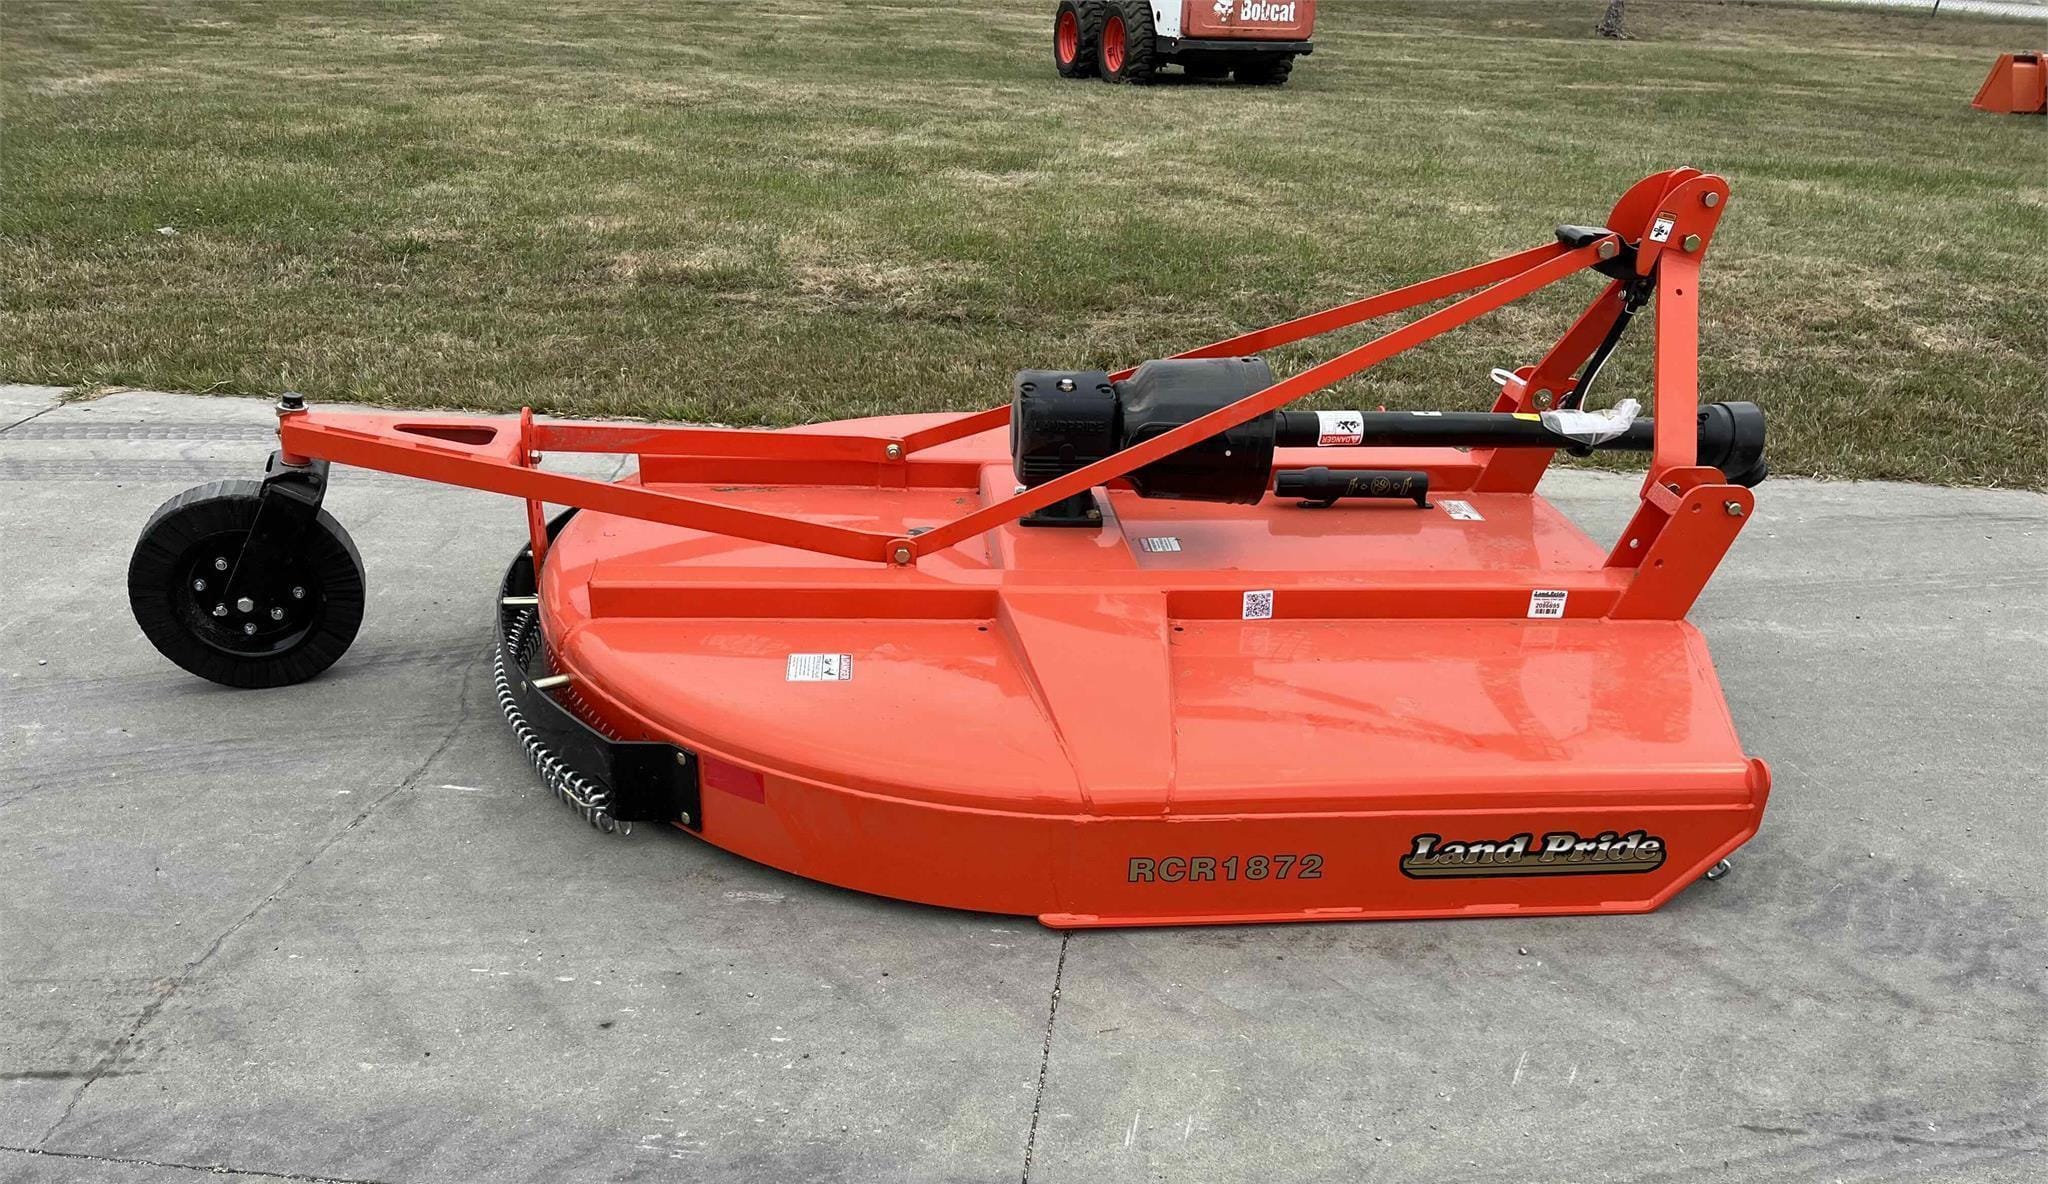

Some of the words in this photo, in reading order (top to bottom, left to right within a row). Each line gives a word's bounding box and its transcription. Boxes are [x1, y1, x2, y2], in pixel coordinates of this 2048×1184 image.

[1240, 0, 1296, 22] Bobcat
[1322, 435, 1351, 444] DANGER
[1408, 833, 1531, 866] Land
[1540, 831, 1663, 864] Pride
[1127, 853, 1324, 883] RCR1872
